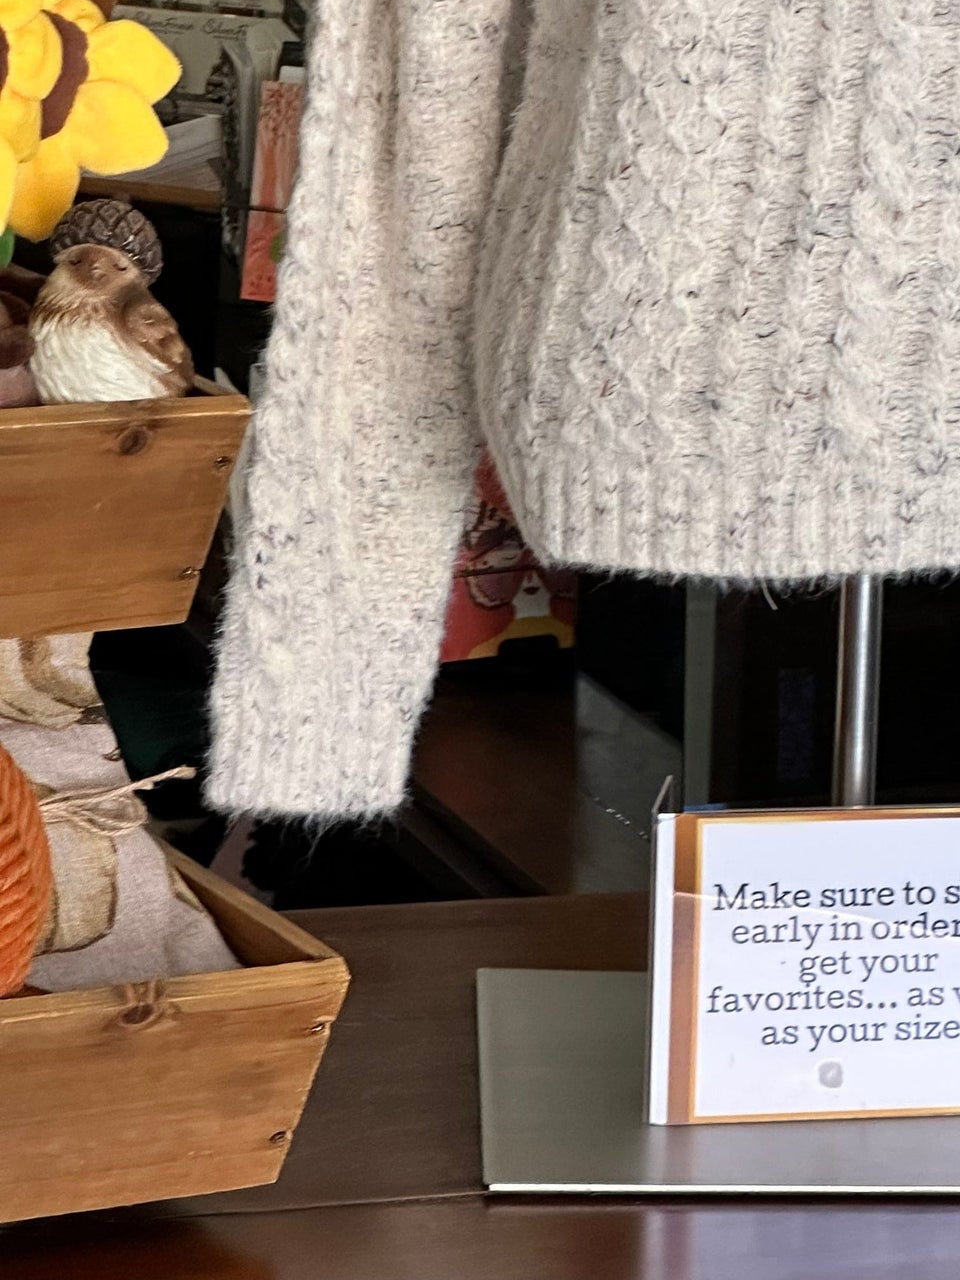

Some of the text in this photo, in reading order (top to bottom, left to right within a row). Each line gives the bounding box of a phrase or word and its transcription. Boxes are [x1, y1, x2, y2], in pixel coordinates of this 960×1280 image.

[712, 882, 811, 911] Make
[819, 885, 895, 907] sure
[902, 881, 936, 905] to
[731, 916, 820, 949] early
[830, 914, 863, 941] in
[799, 951, 939, 983] get your
[706, 982, 898, 1013] favorites...
[907, 987, 945, 1007] as
[761, 1024, 799, 1045] as
[806, 1022, 887, 1052] your
